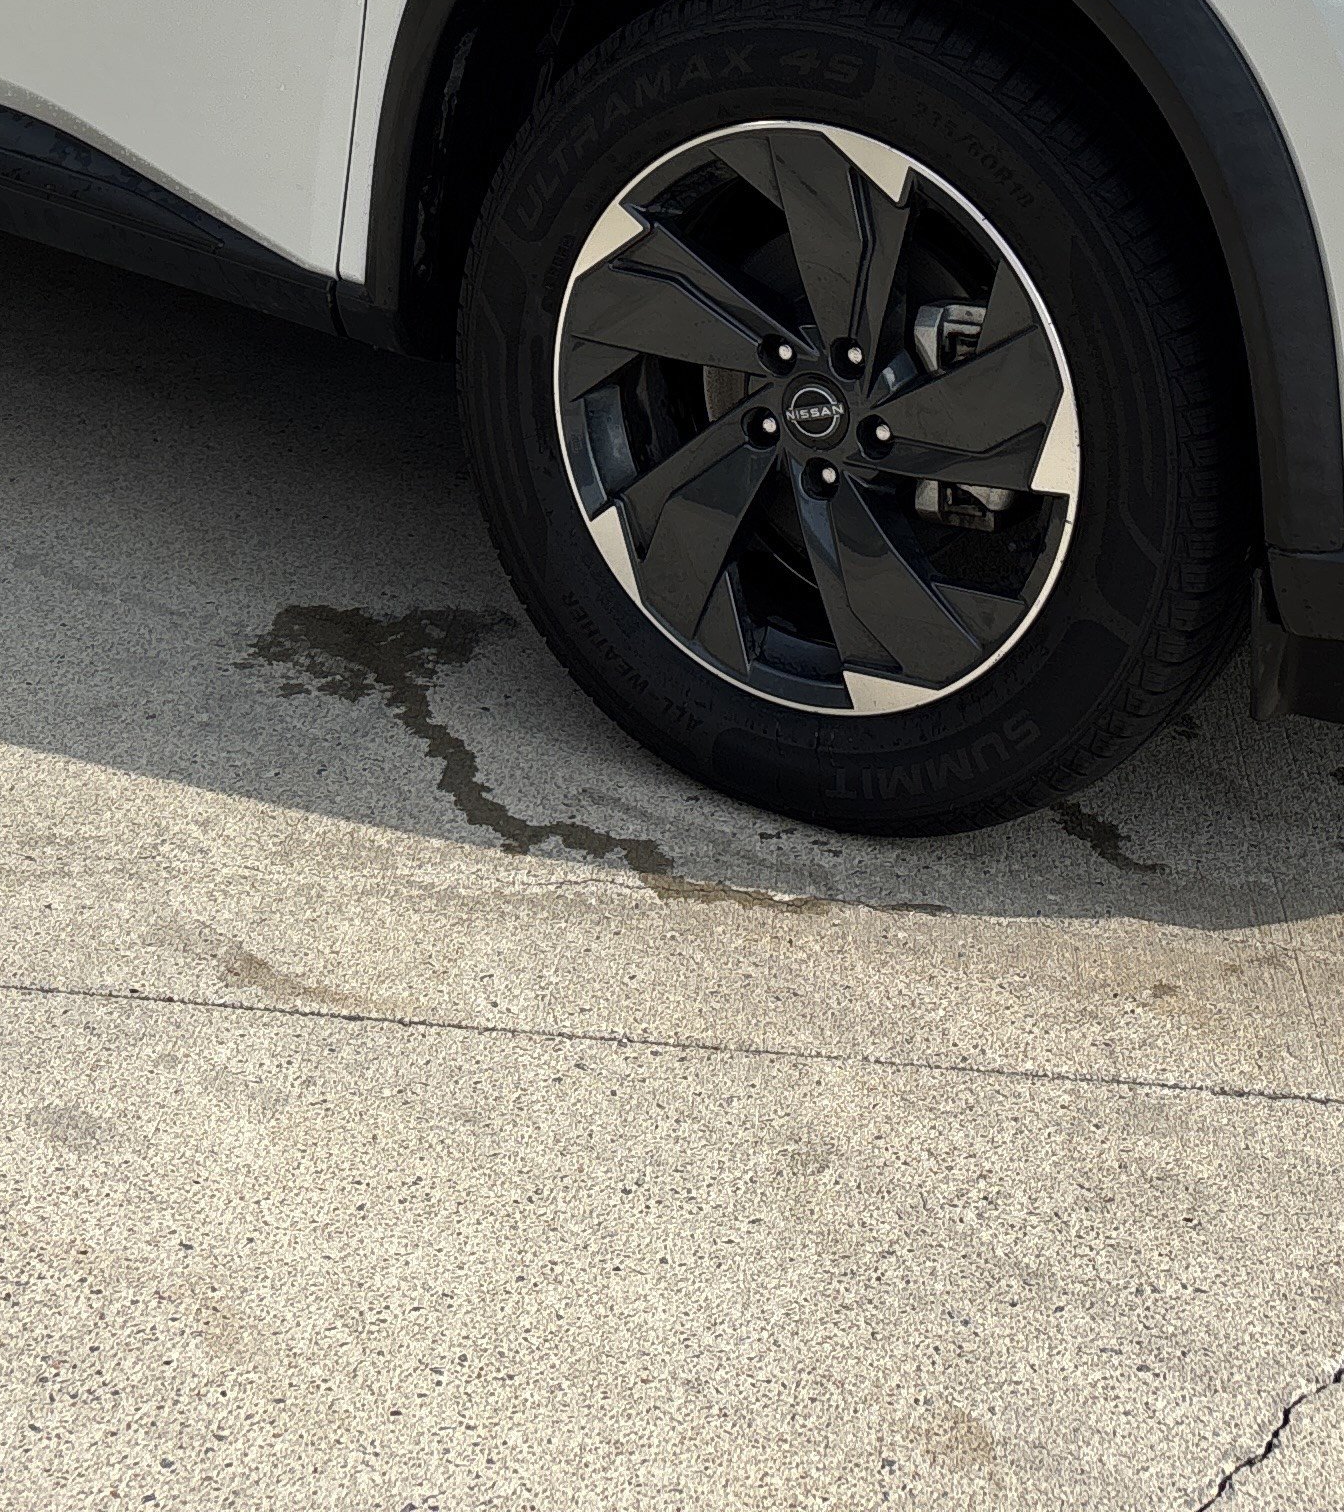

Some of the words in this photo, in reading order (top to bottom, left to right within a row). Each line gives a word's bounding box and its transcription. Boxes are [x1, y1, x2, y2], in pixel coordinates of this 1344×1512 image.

[515, 43, 755, 233] ULTRAMAX
[785, 403, 845, 421] NISSAN
[824, 707, 1043, 801] SUMMIT
